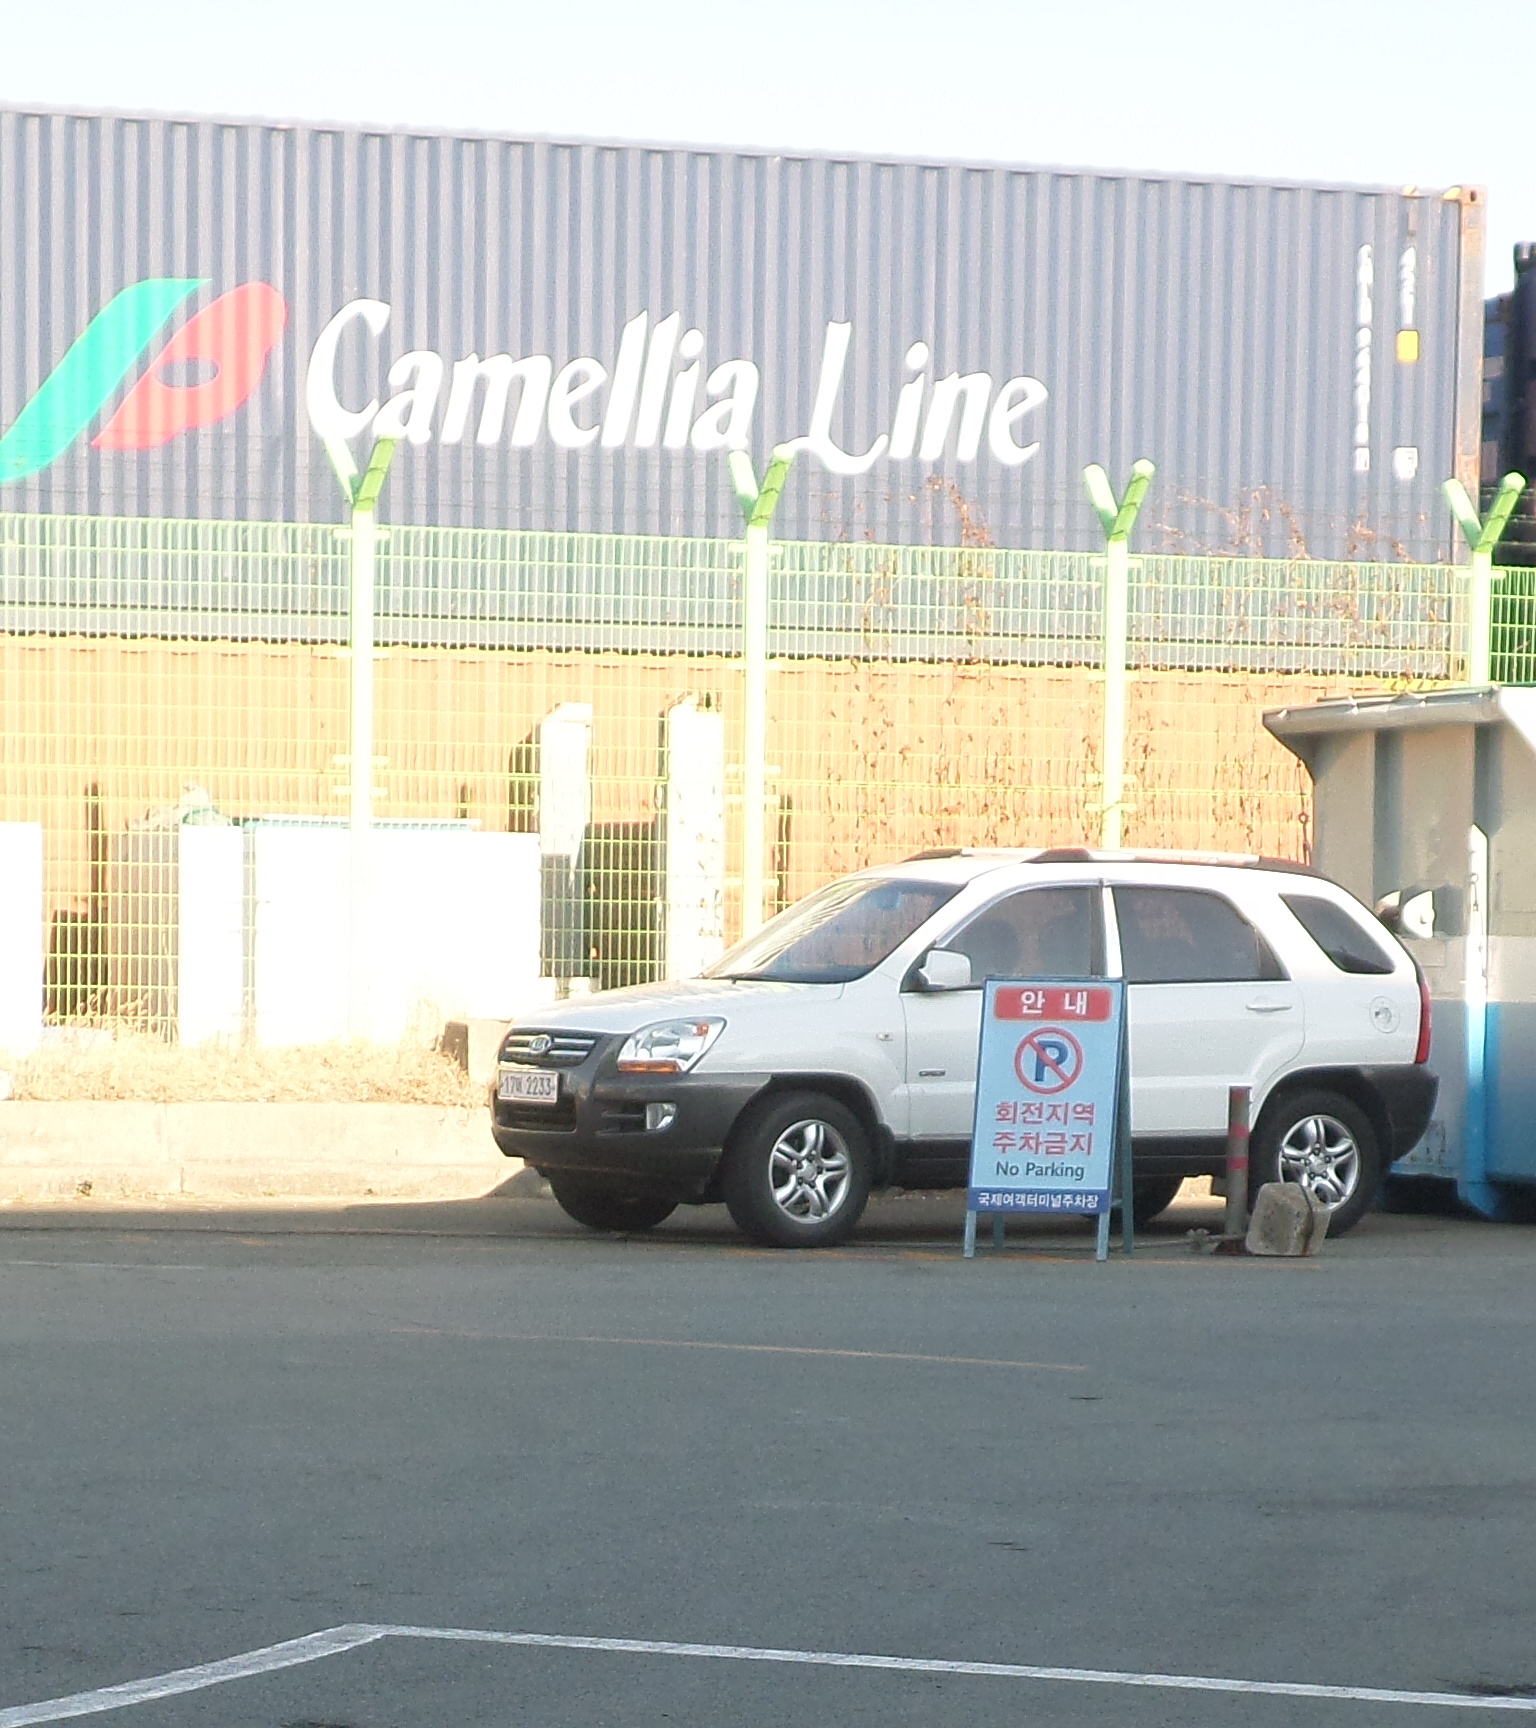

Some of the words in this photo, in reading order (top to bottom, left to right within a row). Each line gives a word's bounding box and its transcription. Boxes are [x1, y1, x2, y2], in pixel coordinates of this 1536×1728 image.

[307, 299, 758, 452] Camellia
[772, 321, 1047, 475] Line
[995, 1101, 1095, 1126] 회전지역
[992, 1131, 1093, 1156] 주차금지
[995, 1161, 1020, 1177] No
[1025, 1161, 1085, 1181] Parking
